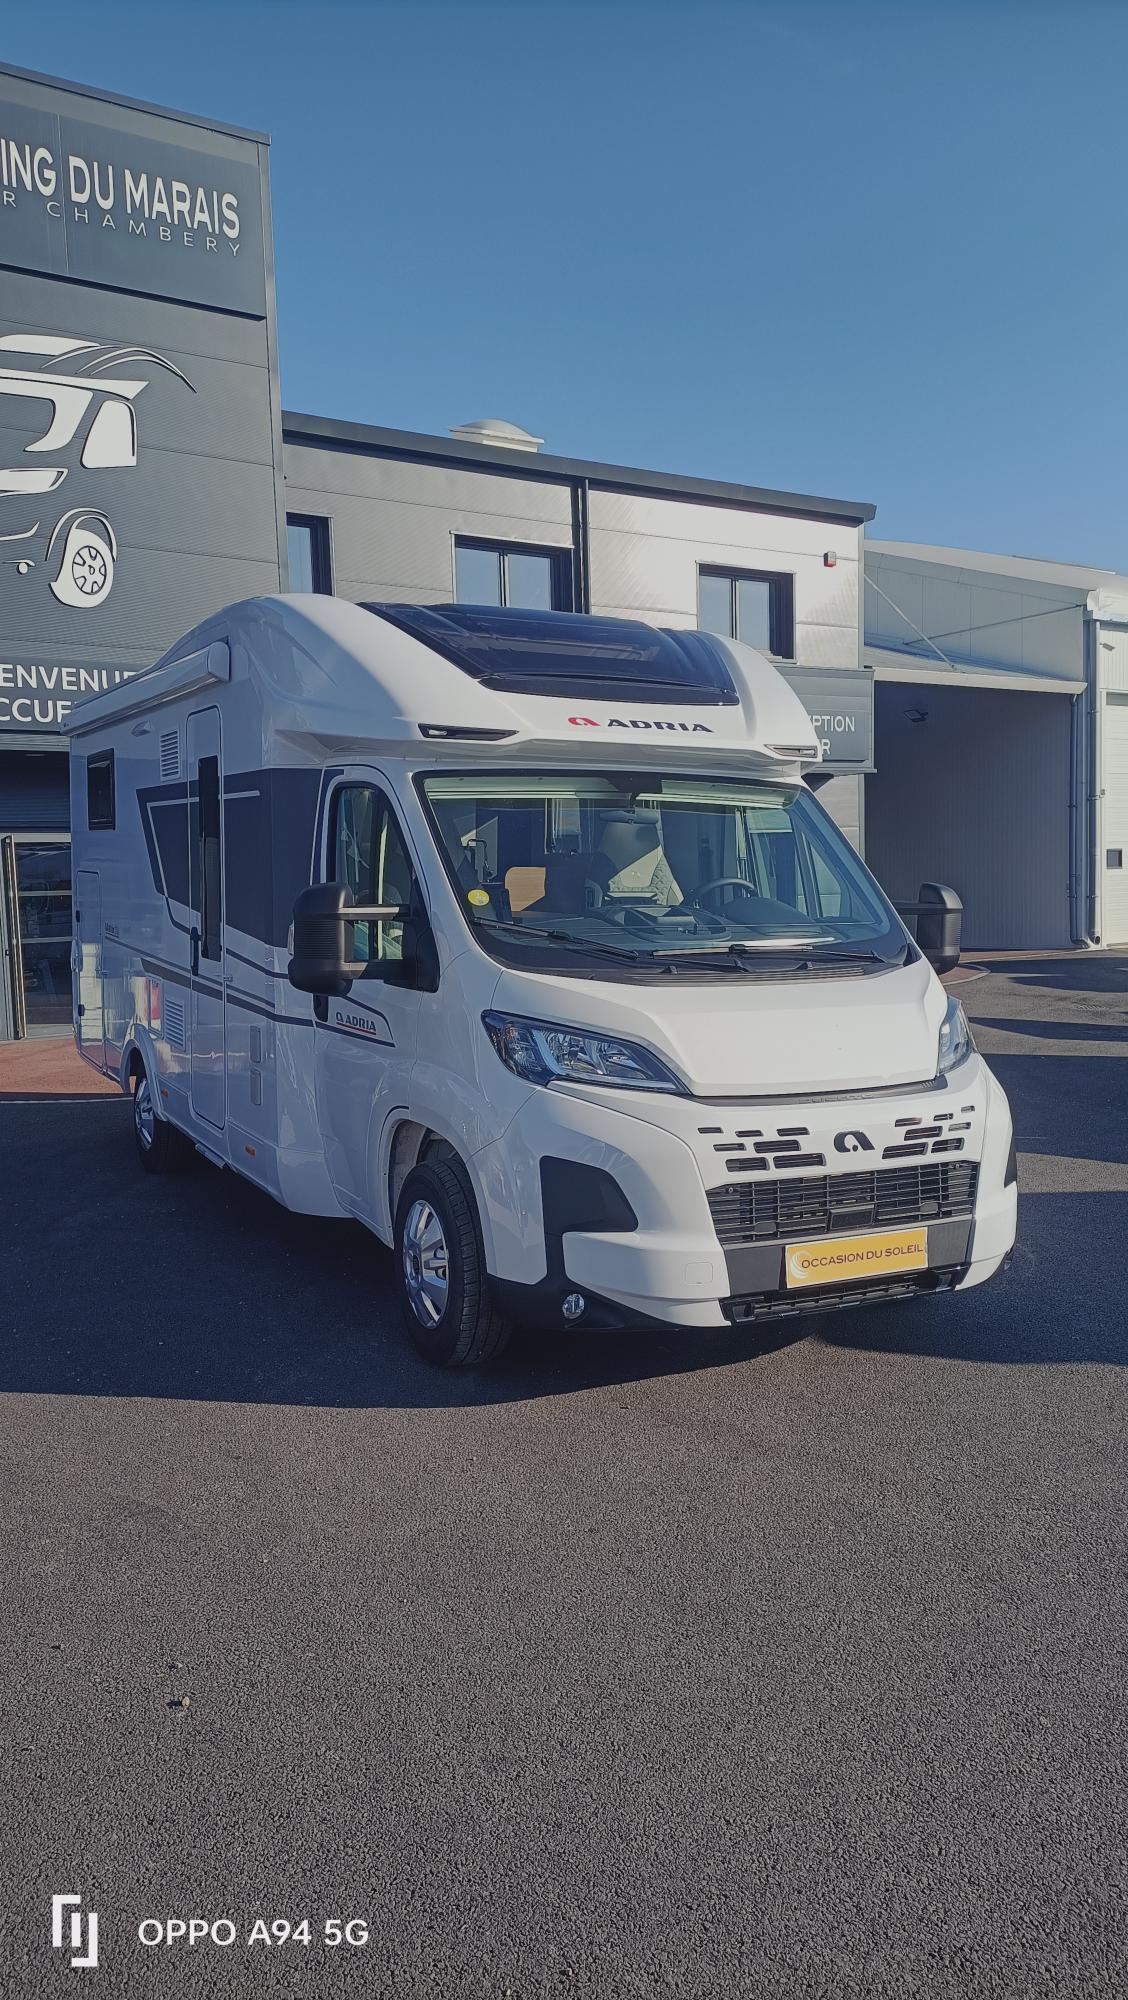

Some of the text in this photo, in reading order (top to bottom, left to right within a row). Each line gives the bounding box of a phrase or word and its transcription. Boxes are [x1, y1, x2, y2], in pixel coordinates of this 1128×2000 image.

[1, 138, 240, 239] ING DU MARAIS
[3, 190, 240, 256] R CHAMBERY
[0, 697, 78, 723] CCUE
[608, 718, 714, 733] ADRIA
[808, 715, 855, 732] PTION
[345, 1014, 376, 1032] ADRIA
[801, 1244, 923, 1269] OCCASION DU SOLEIL
